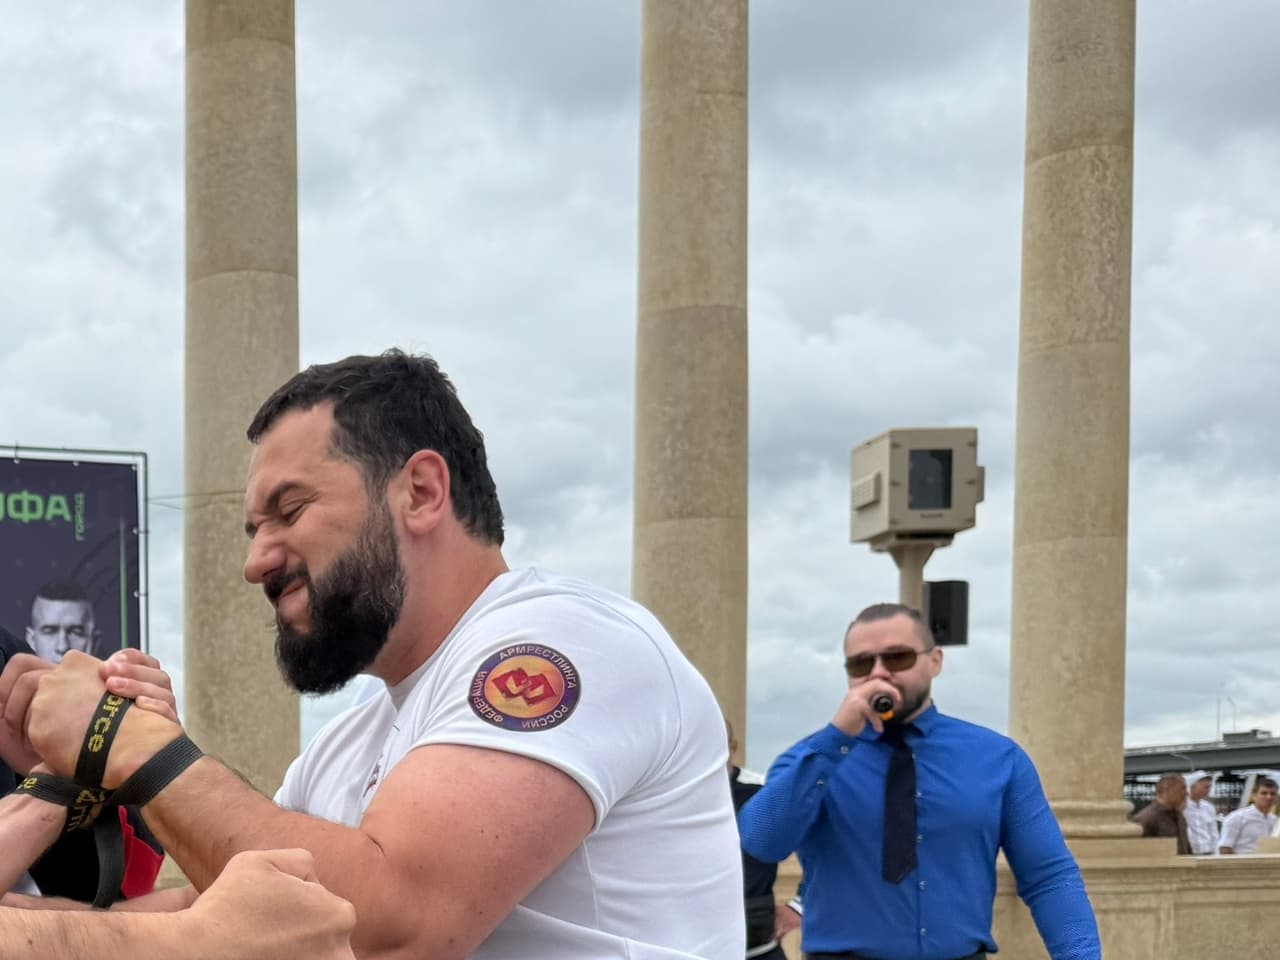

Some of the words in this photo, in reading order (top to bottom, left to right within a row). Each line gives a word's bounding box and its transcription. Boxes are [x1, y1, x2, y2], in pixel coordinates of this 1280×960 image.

[499, 645, 577, 689] АРМРЕСТЛИНГА
[471, 671, 504, 723] ФЕДЕРАЦИЯ
[522, 704, 569, 728] РОССИИ
